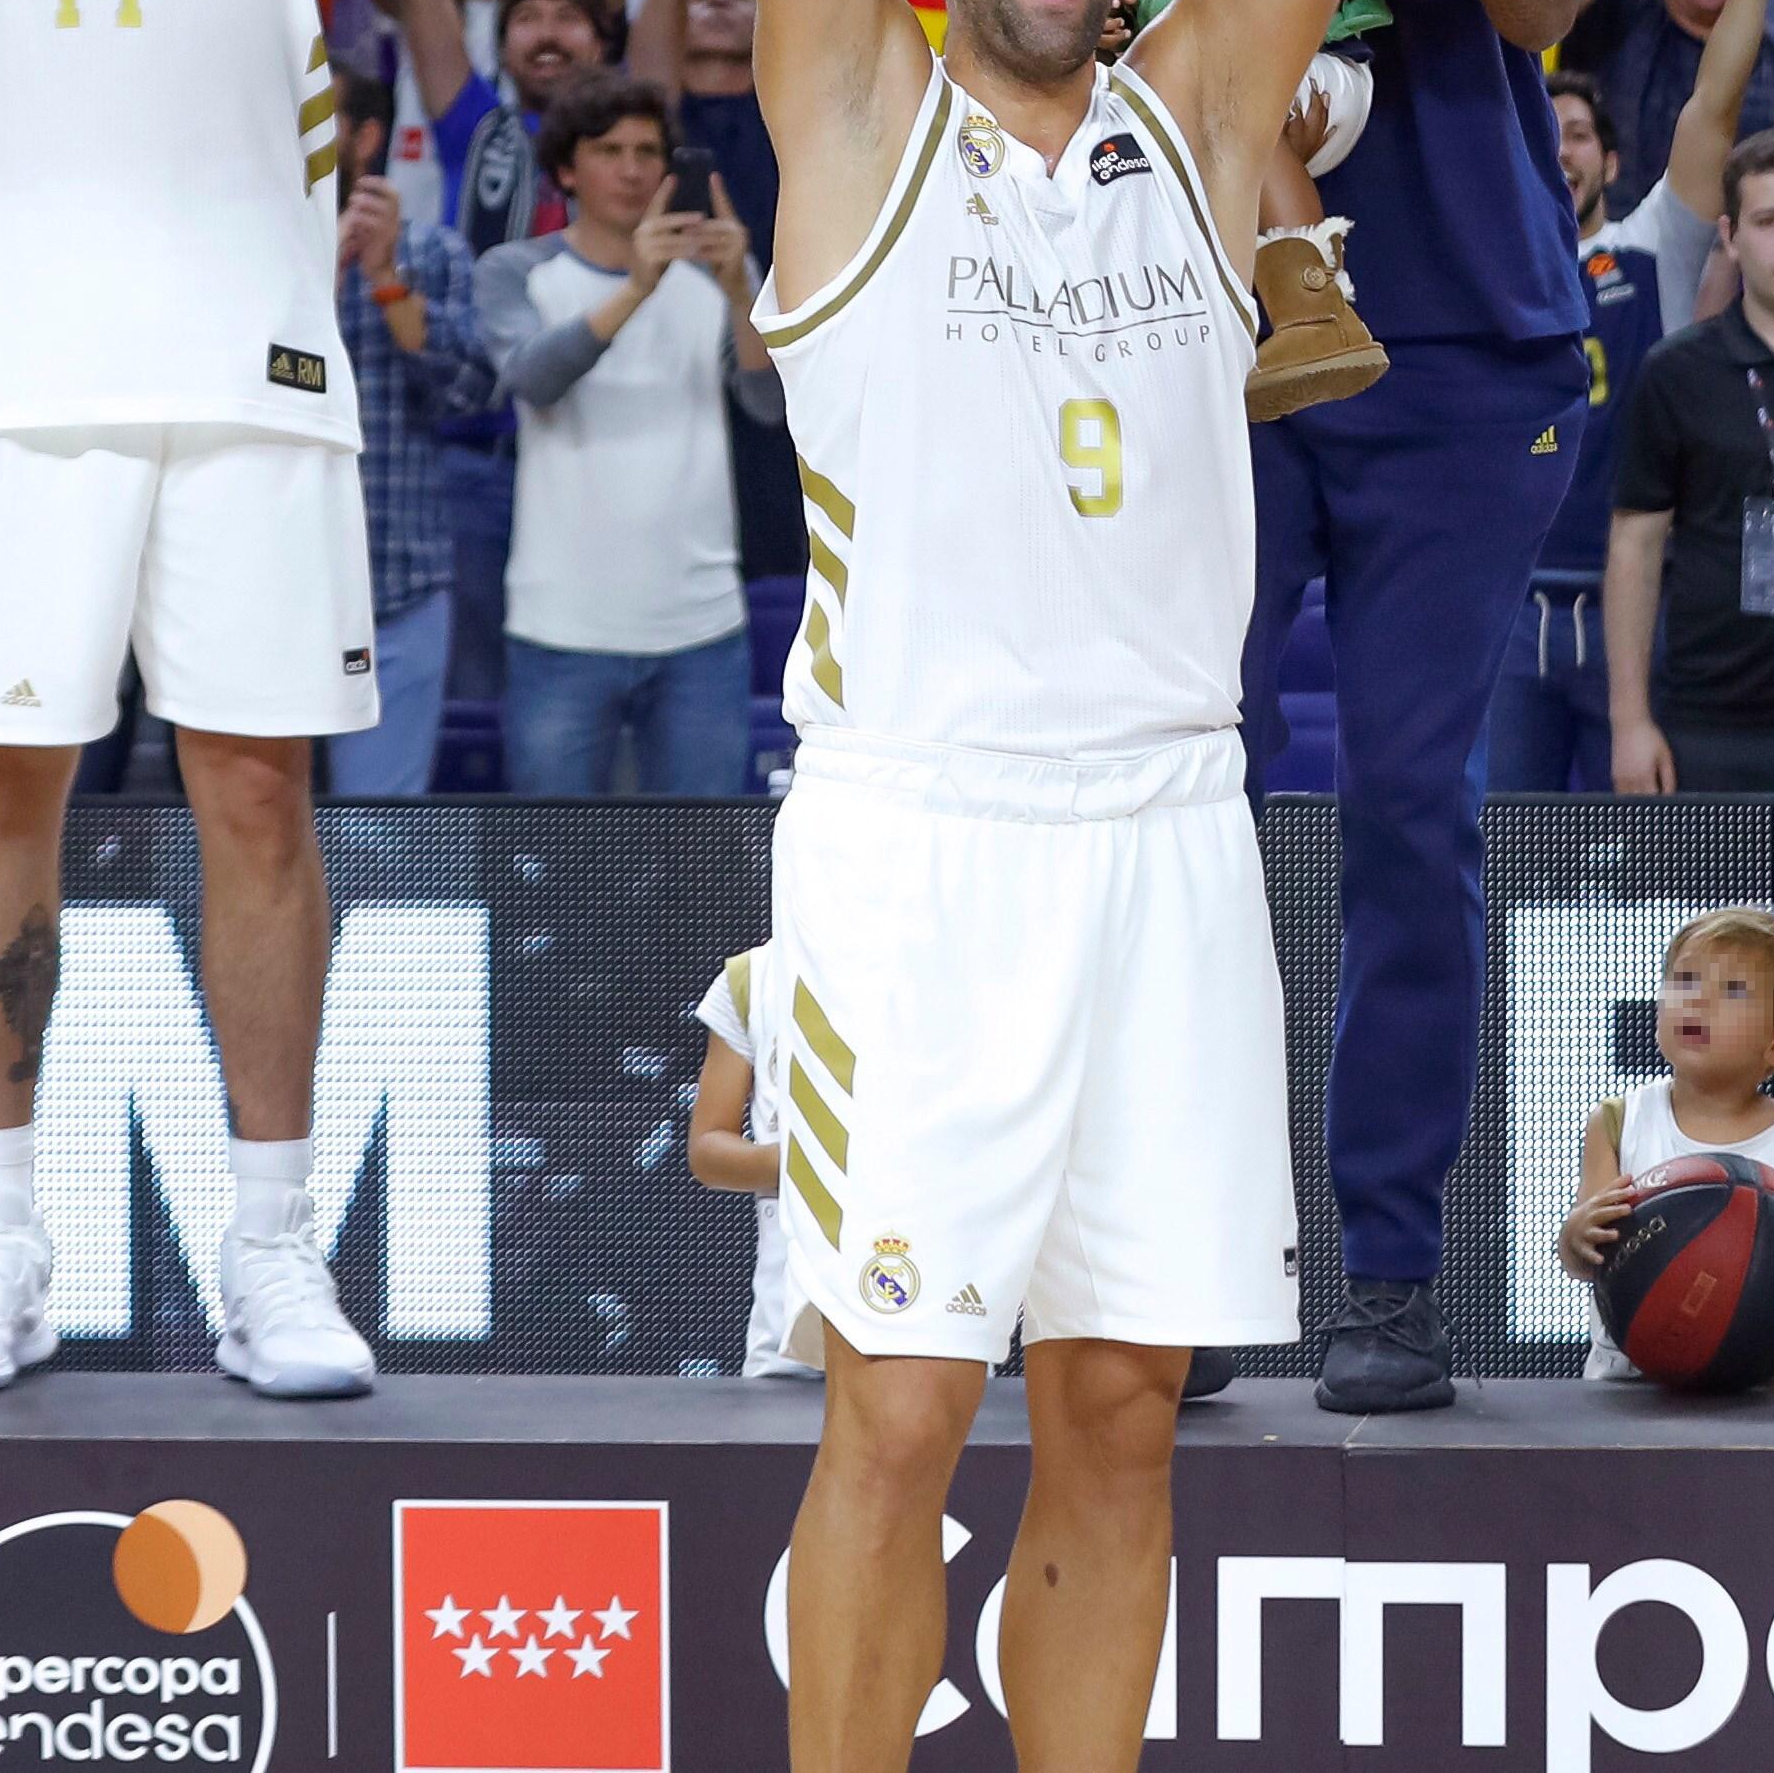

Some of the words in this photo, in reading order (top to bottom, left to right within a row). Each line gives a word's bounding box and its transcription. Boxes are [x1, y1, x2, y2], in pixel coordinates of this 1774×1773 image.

[1098, 155, 1149, 181] endesa
[947, 254, 1205, 327] PALLADIUM
[1093, 324, 1211, 363] GROUP
[297, 356, 324, 388] RM
[1059, 398, 1123, 517] 9
[945, 1301, 987, 1317] adidas
